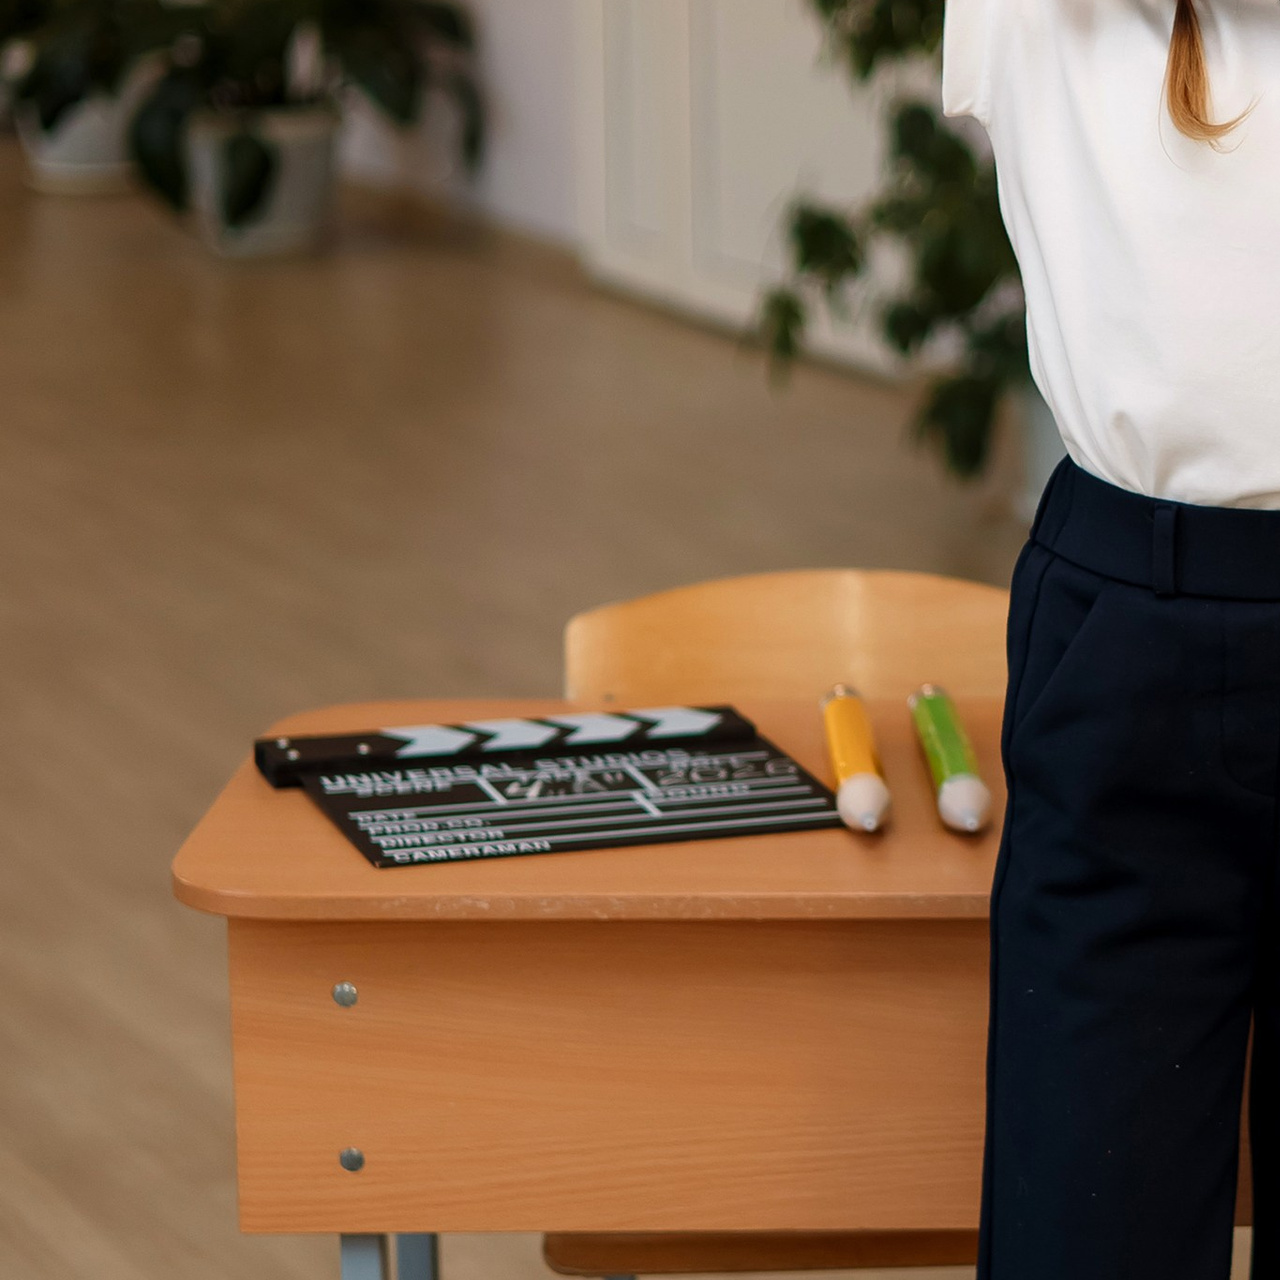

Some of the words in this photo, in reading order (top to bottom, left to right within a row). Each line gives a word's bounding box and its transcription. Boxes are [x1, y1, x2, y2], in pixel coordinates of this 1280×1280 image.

[320, 763, 524, 791] UNIVERSAL
[379, 830, 504, 849] DIRECTOR
[393, 841, 551, 863] CAMERAMAN
